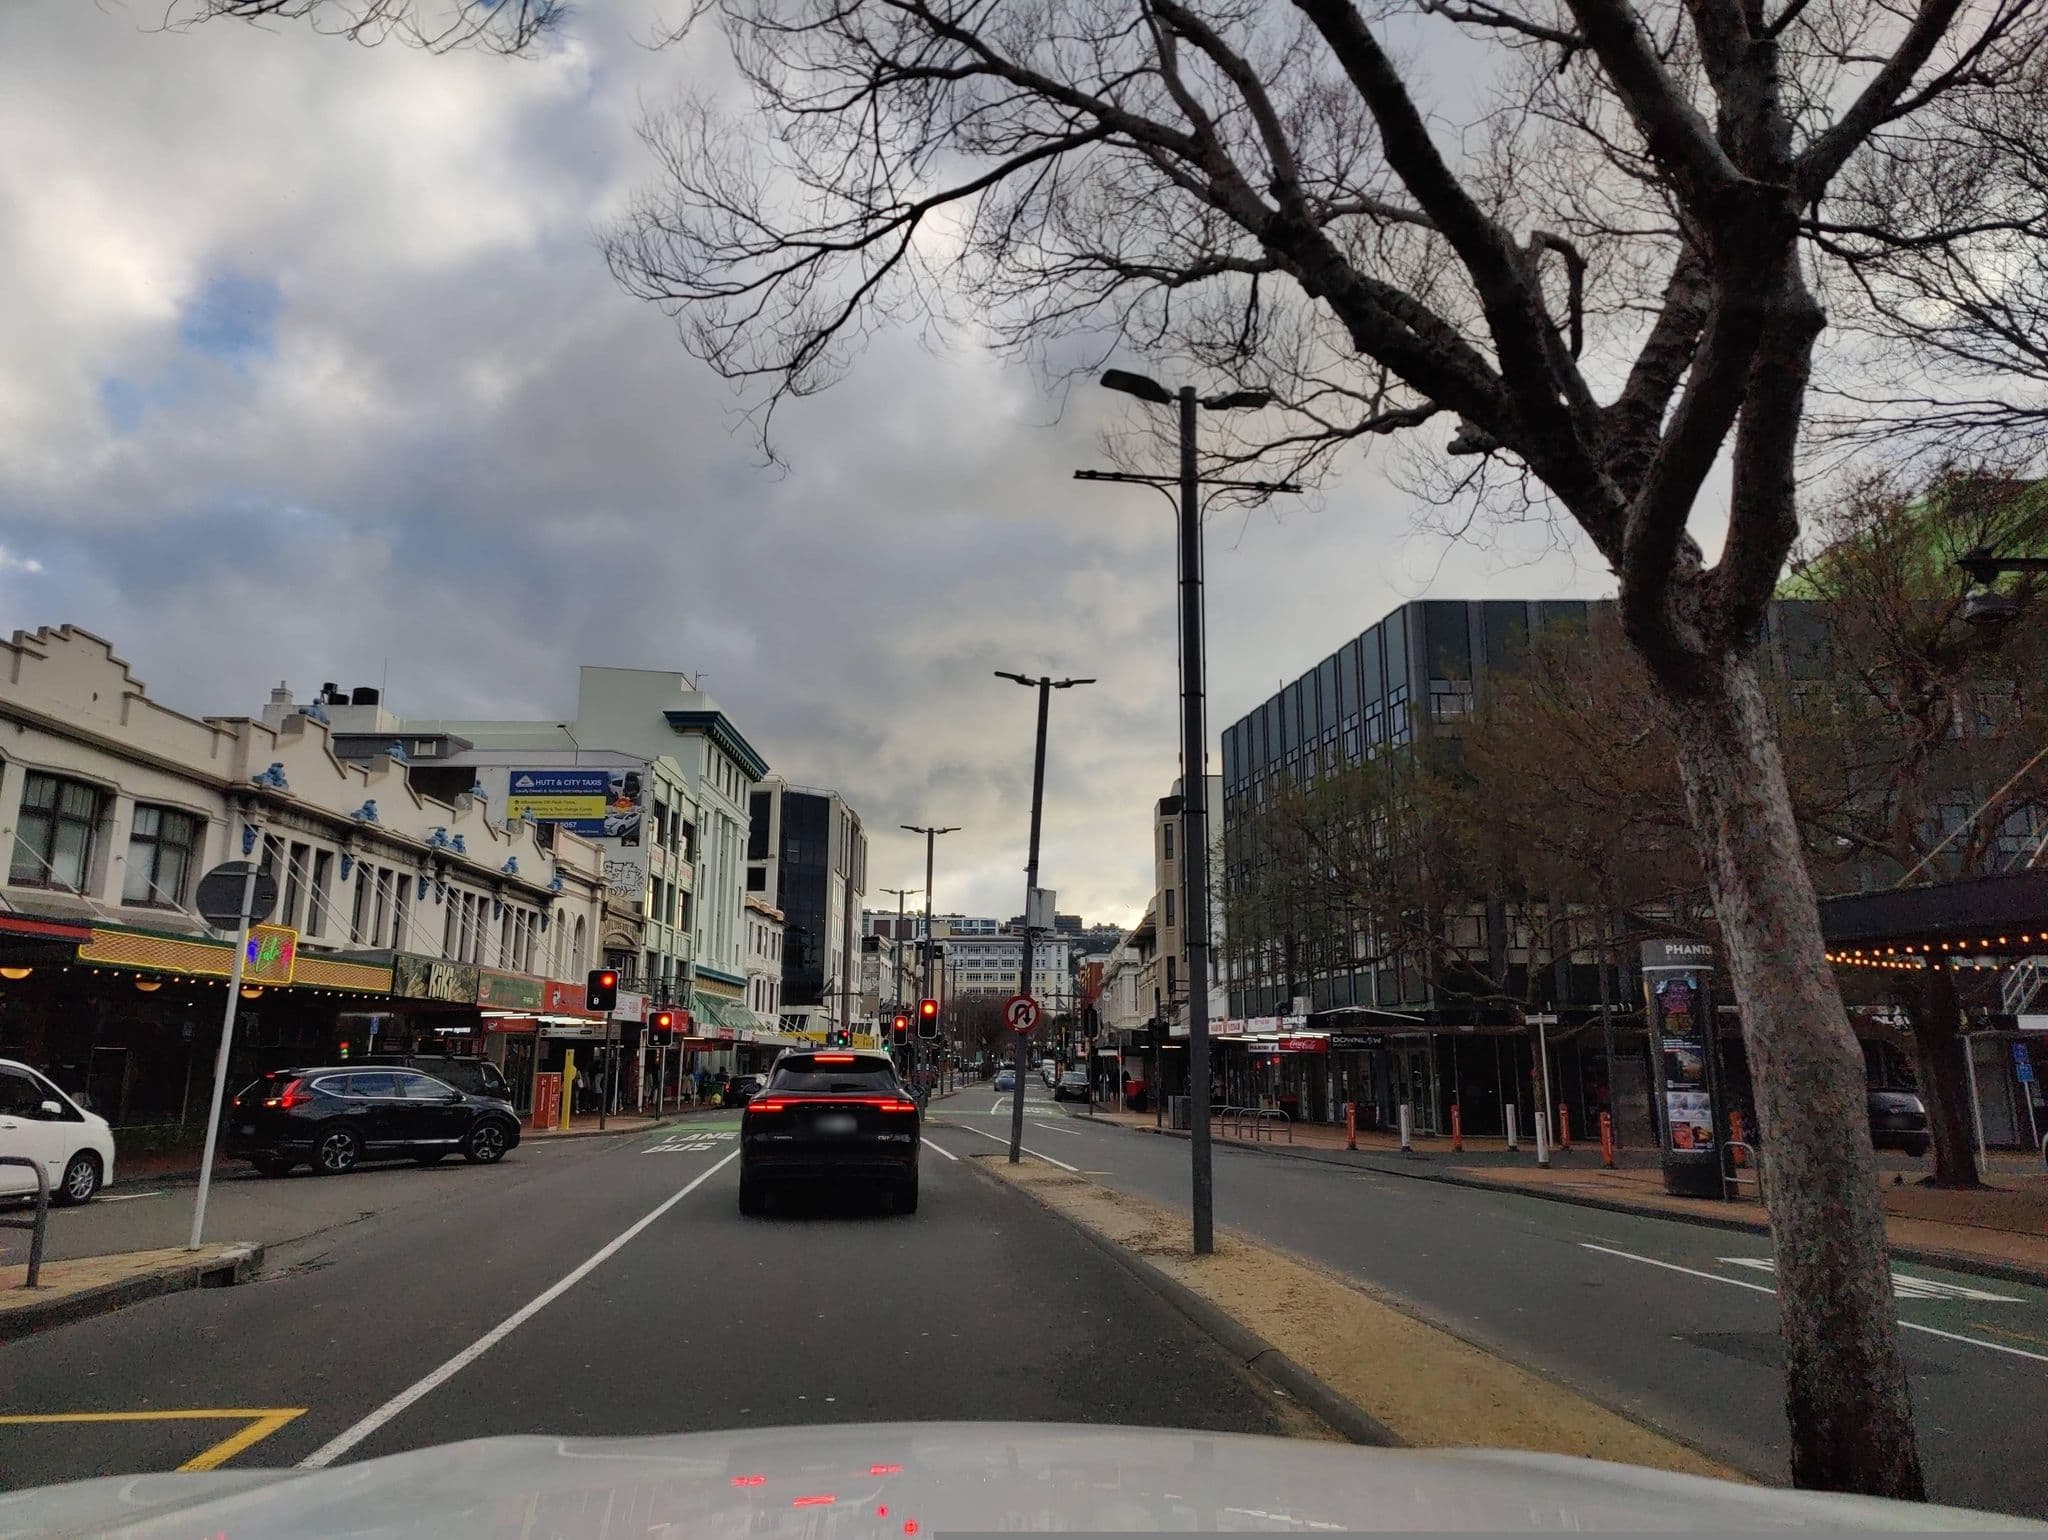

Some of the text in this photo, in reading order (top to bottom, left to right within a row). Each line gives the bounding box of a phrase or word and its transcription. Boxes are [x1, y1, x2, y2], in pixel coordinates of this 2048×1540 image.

[1665, 944, 1712, 956] PHANTO
[661, 1132, 739, 1144] LANE
[640, 1142, 718, 1154] BUS
